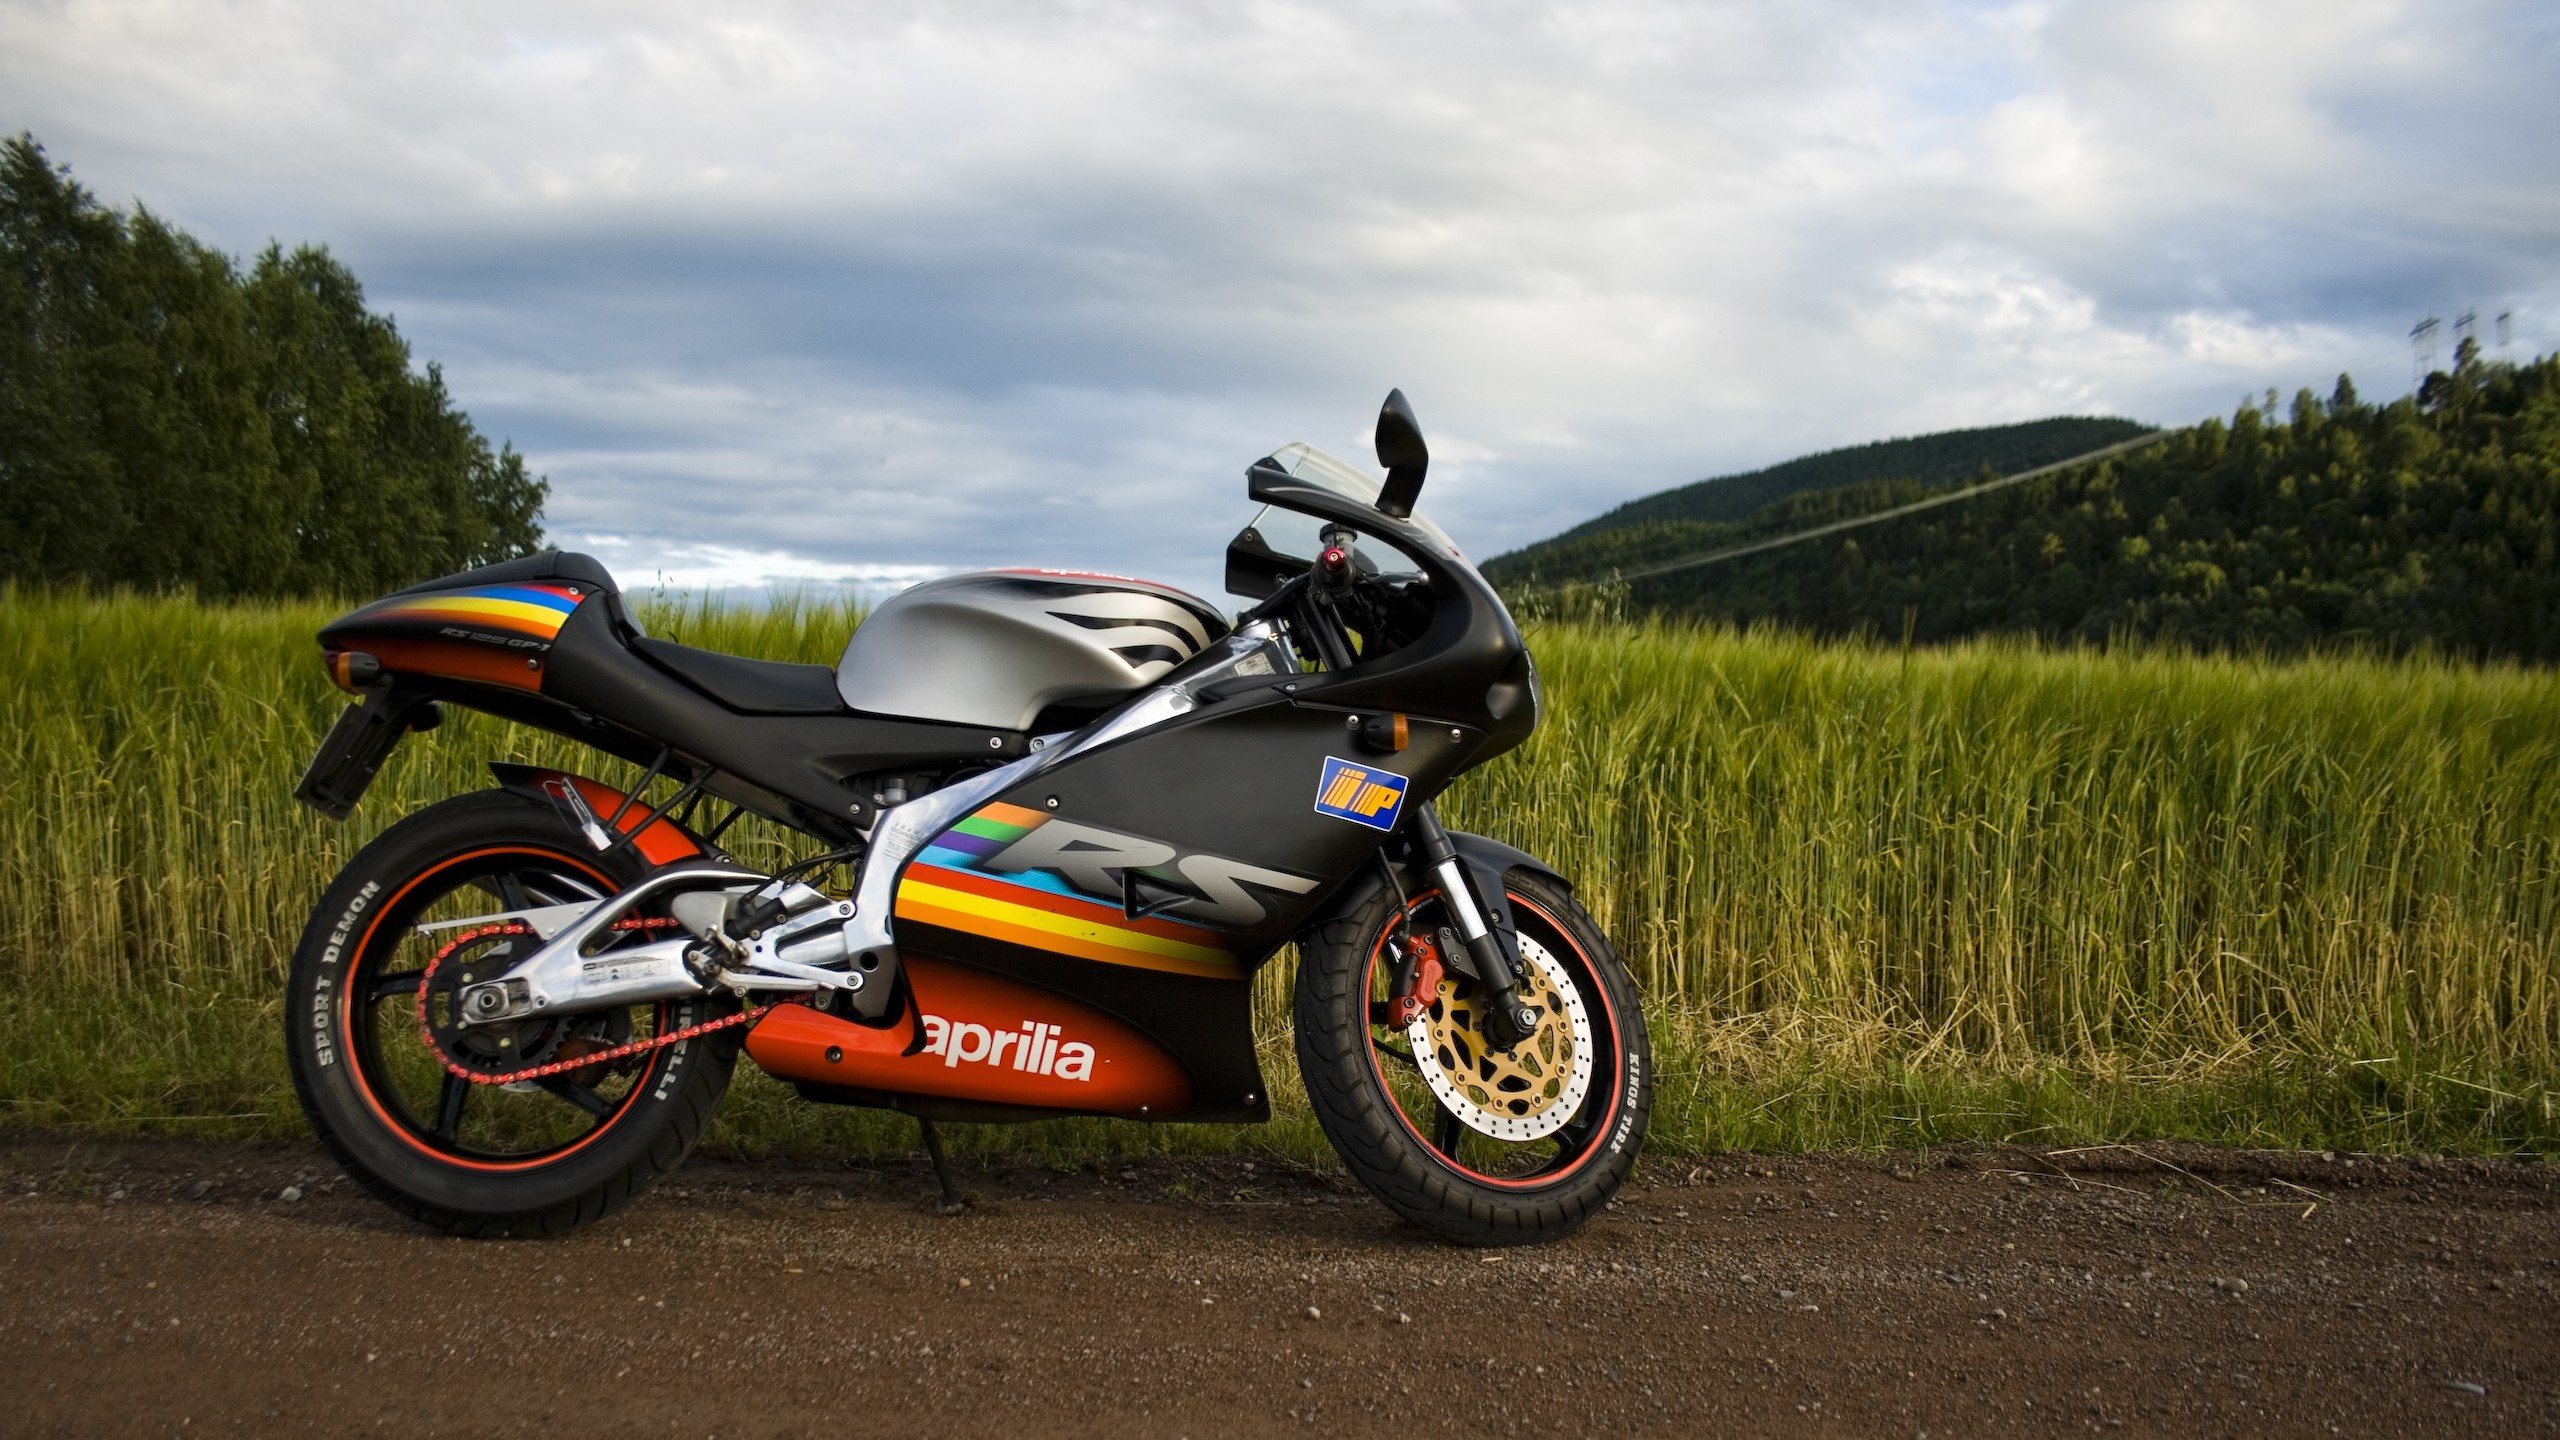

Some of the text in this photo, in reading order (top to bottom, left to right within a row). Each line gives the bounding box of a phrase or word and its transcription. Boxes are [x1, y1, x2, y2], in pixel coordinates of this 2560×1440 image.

[440, 627, 471, 638] RS
[313, 879, 382, 1068] SPORT DEMON
[920, 1014, 1096, 1082] aprilia
[1610, 1051, 1641, 1154] KINGS TIRE
